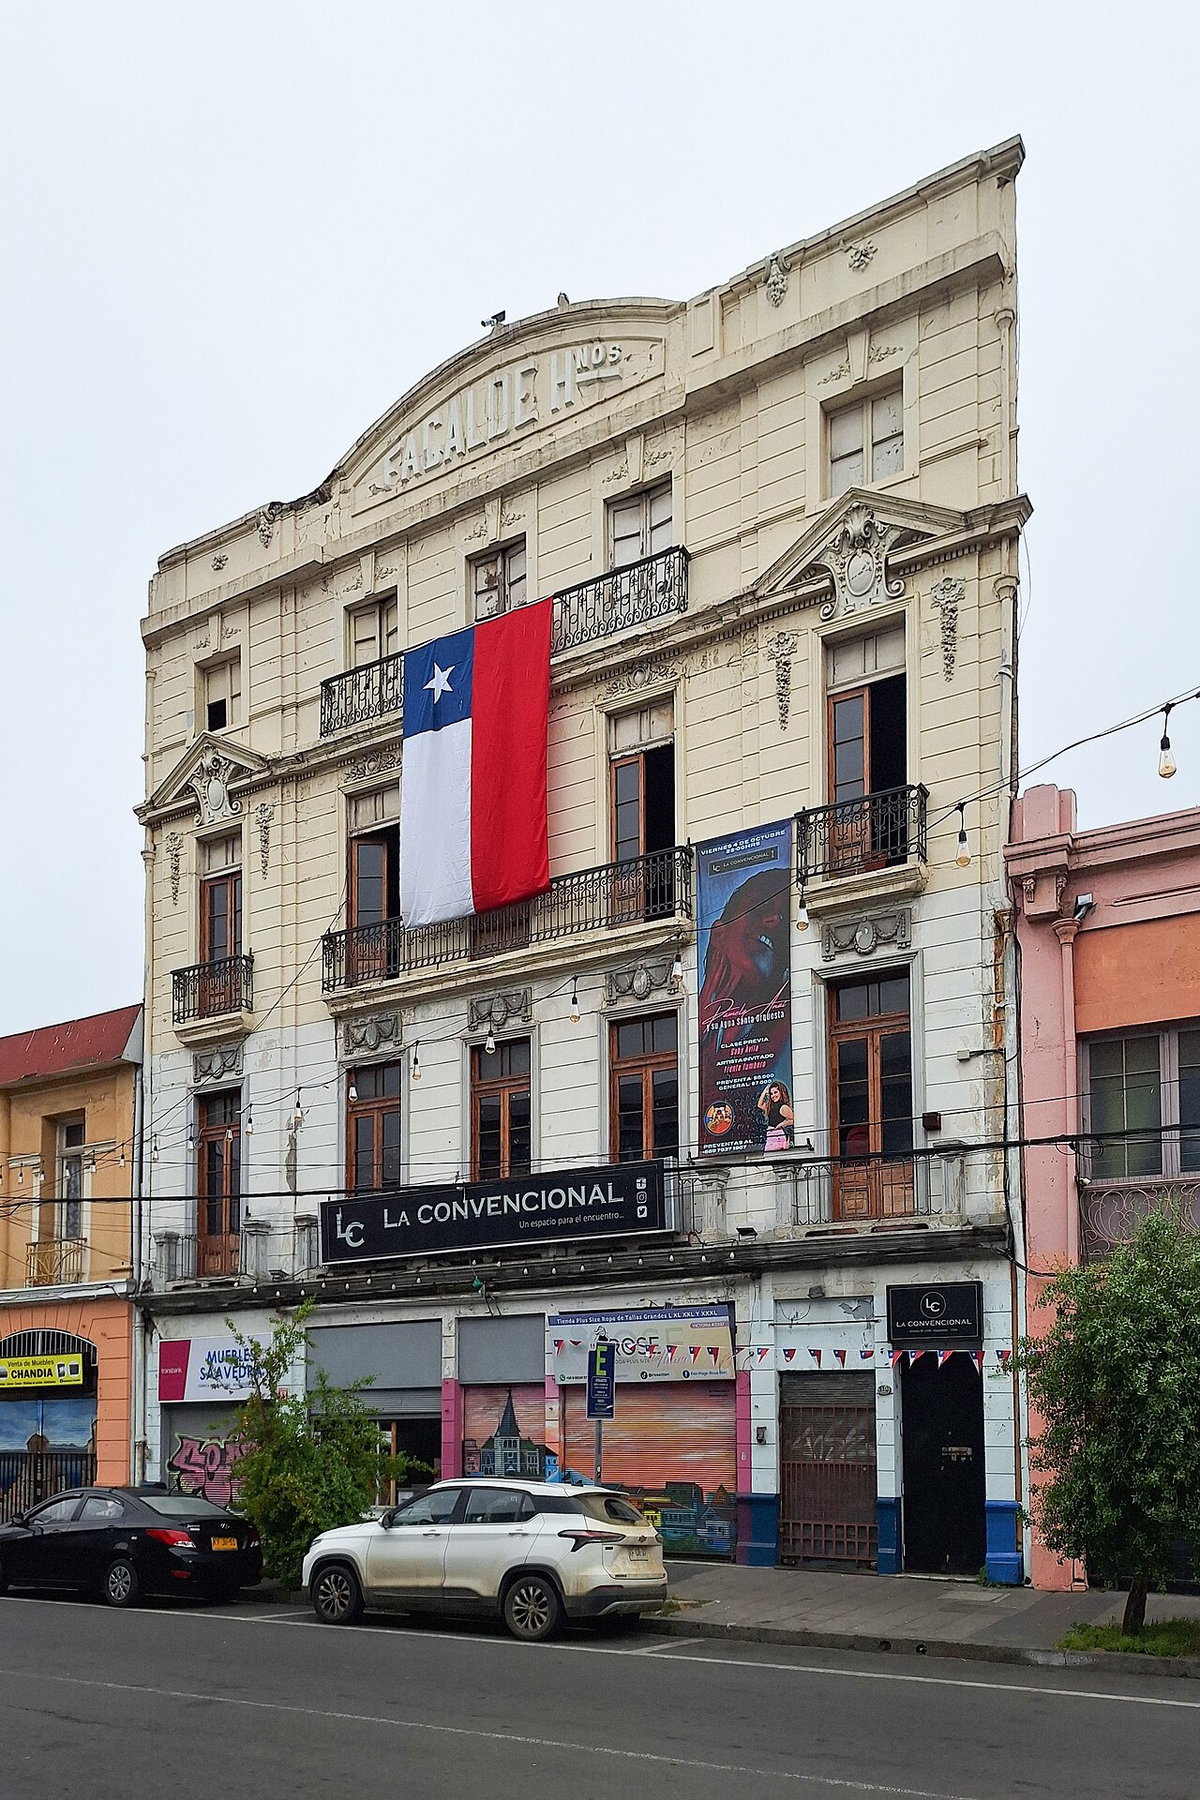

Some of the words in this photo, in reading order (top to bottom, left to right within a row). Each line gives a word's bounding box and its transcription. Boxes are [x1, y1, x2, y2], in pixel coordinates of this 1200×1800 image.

[701, 844, 733, 856] VIERNES
[751, 830, 786, 843] OCTUBRE
[730, 852, 769, 865] CONVENCIONAL
[720, 1019, 735, 1029] Agua
[736, 1016, 754, 1026] Santa
[720, 1041, 742, 1049] CLASE
[743, 1037, 769, 1045] PREVIA
[716, 1058, 743, 1067] ARTISTA
[743, 1053, 775, 1062] INVITADO
[703, 1140, 743, 1149] PREVENTAS
[336, 1207, 365, 1248] LC
[417, 1182, 624, 1224] CONVENCIONAL
[519, 1220, 529, 1229] Un
[530, 1218, 556, 1228] espacio
[558, 1217, 574, 1226] para
[575, 1214, 581, 1223] el
[926, 1298, 940, 1312] LC
[907, 1319, 972, 1327] CONVENCIONAL
[596, 1345, 608, 1376] E
[11, 1368, 53, 1379] CHANDIA
